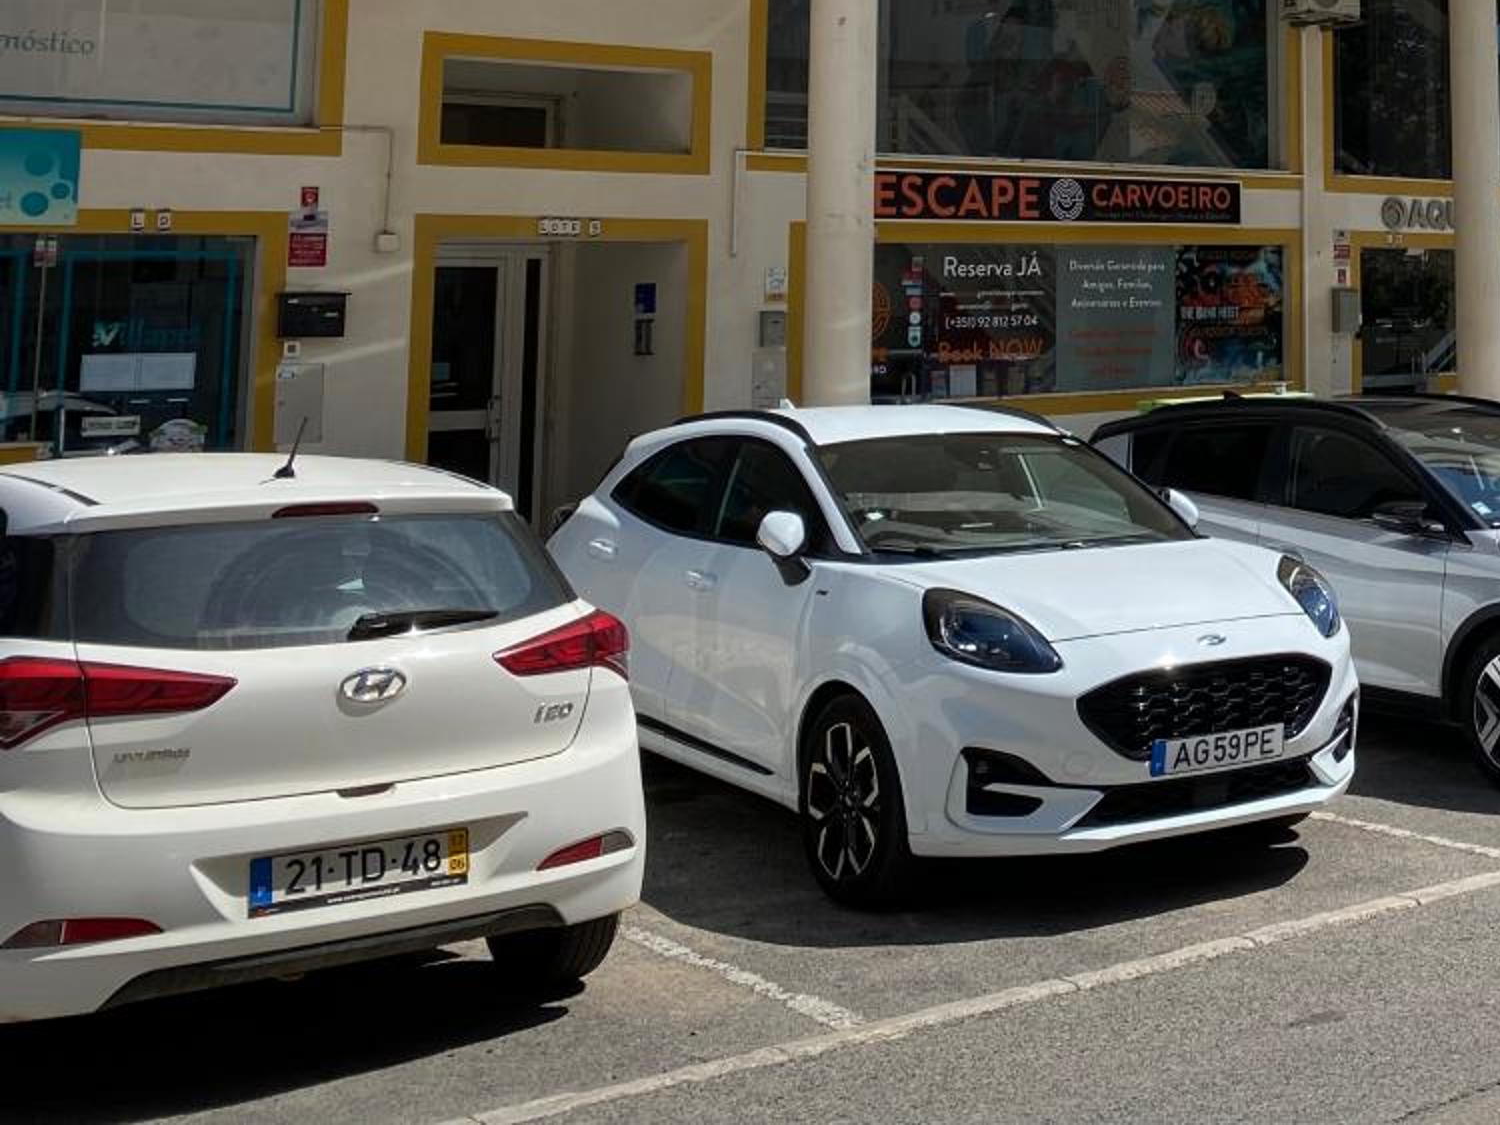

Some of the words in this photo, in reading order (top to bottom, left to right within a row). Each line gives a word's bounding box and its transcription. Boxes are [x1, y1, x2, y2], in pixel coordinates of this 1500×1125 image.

[874, 174, 1041, 218] ESCAPE
[1091, 183, 1232, 210] CARVOEIRO
[943, 256, 1013, 278] Reserva
[1017, 250, 1042, 277] JÁ
[989, 335, 1044, 359] NOW
